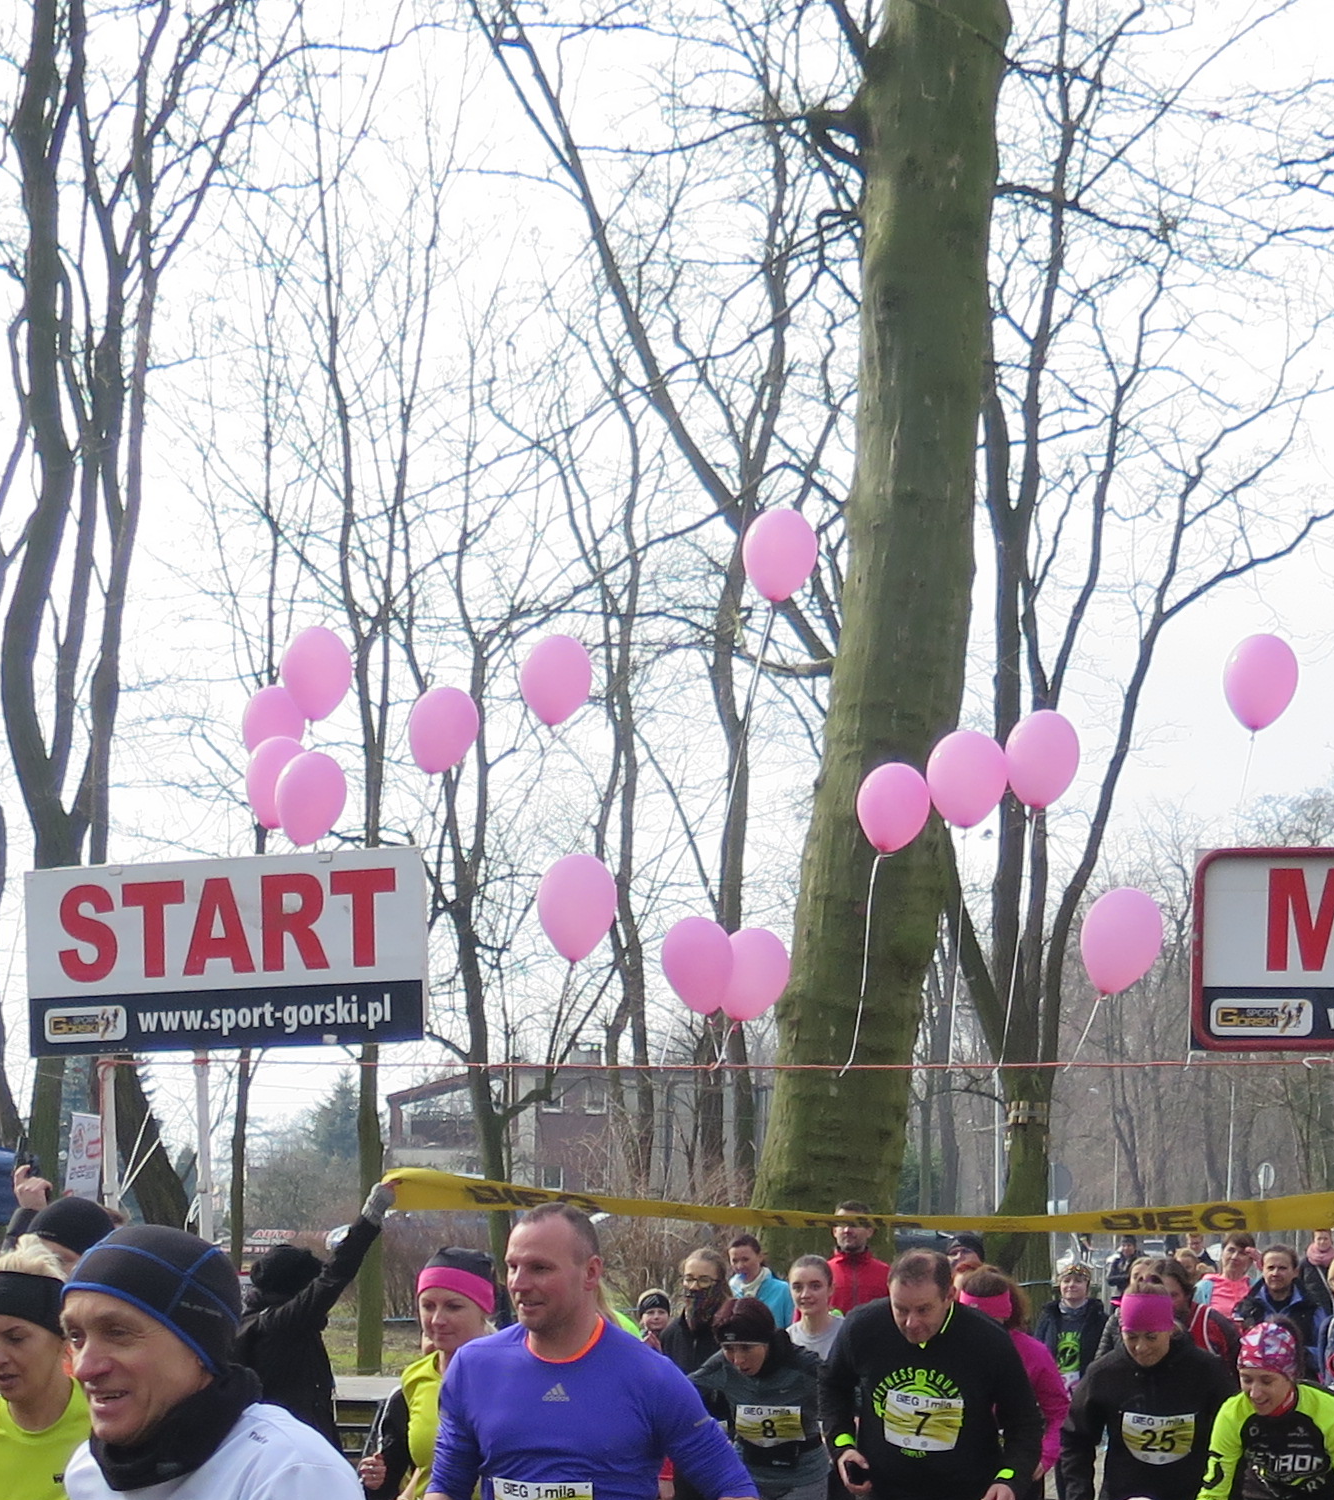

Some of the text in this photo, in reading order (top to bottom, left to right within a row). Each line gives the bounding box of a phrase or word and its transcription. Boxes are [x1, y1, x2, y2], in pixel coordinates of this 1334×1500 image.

[58, 868, 396, 983] START
[138, 993, 392, 1034] www.sport-gorski.pl
[873, 1367, 914, 1400] FITNESS
[761, 1419, 777, 1438] 8
[914, 1410, 932, 1436] 7
[1141, 1429, 1176, 1452] 25
